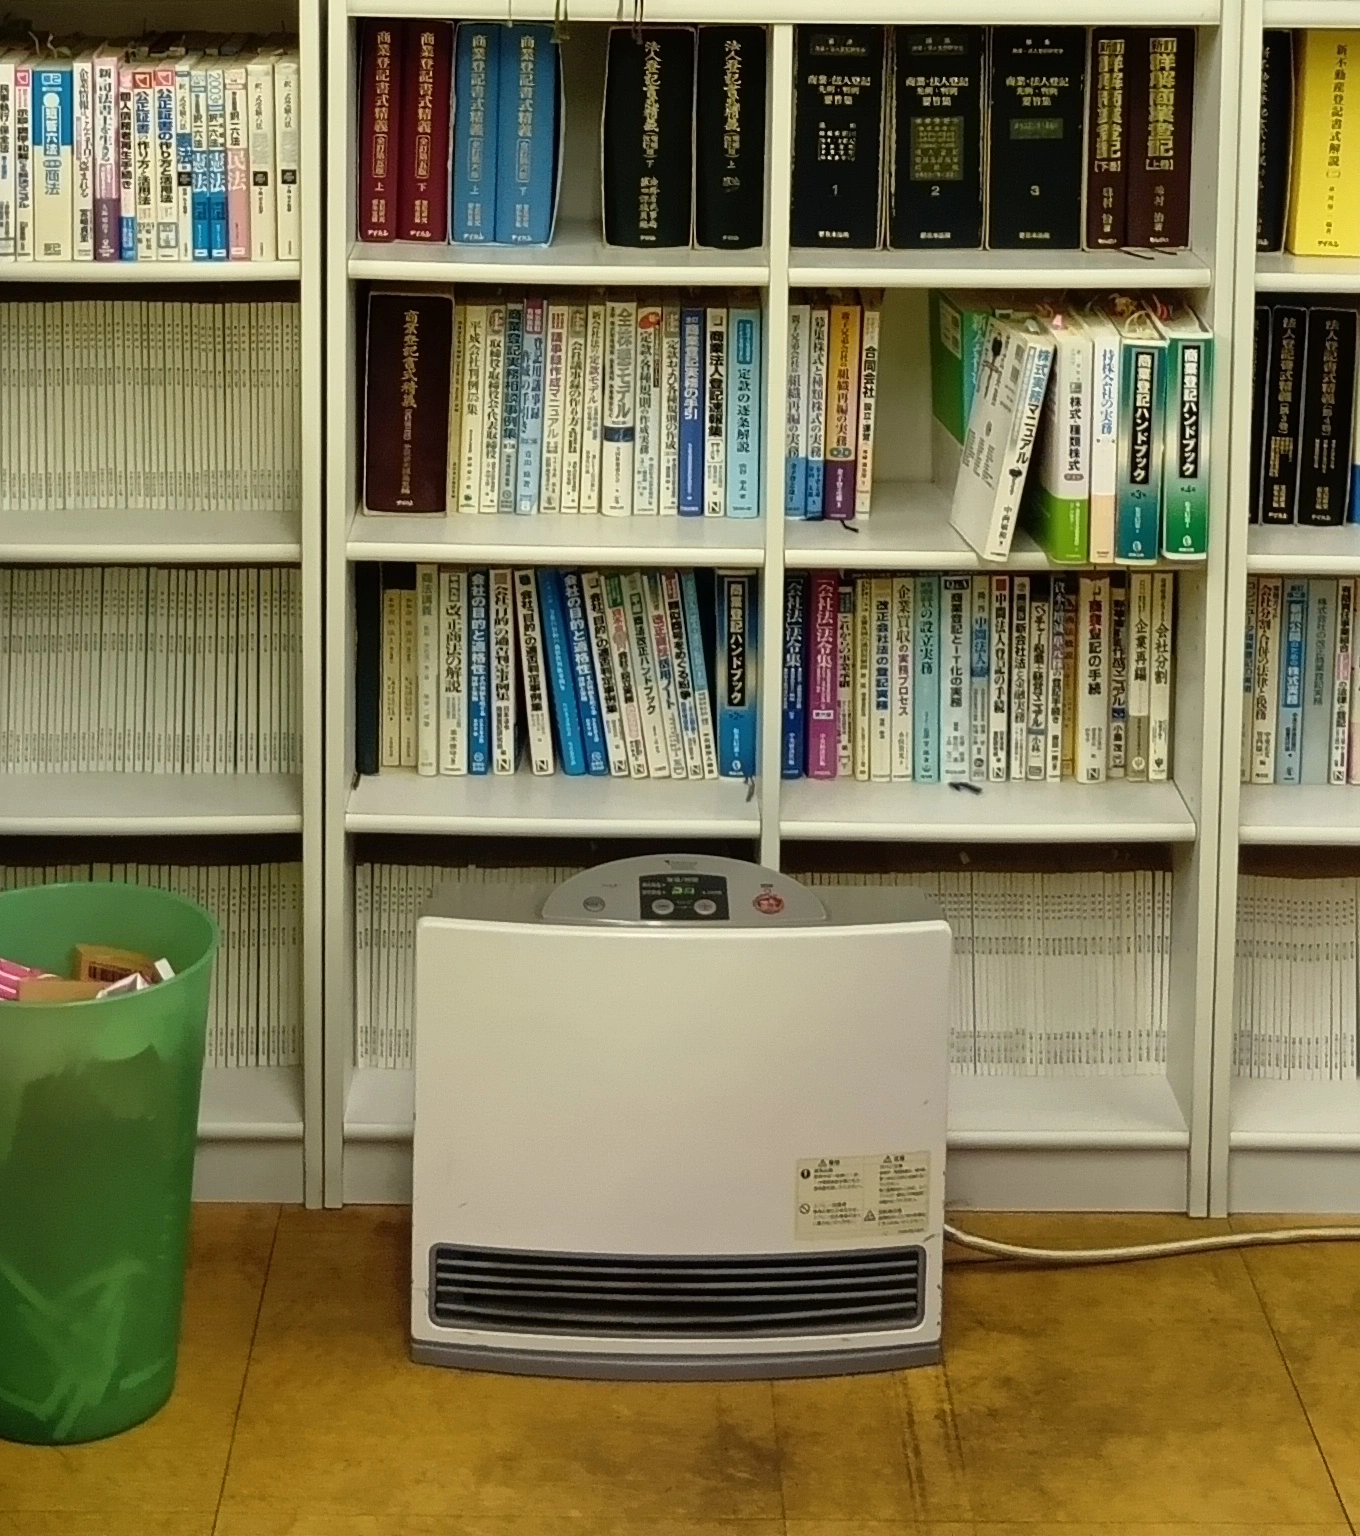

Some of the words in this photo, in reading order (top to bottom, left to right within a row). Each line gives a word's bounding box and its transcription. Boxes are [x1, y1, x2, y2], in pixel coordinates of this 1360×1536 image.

[374, 30, 391, 133] 商業登記書式精義
[416, 32, 435, 134] 商業登記書式精義
[469, 35, 487, 137] 商業登記書式精義
[518, 35, 536, 138] 商業登記書式精義
[808, 74, 871, 87] 商業・法人登記
[905, 75, 969, 88] 商業・法人登記
[1005, 75, 1070, 88] 商業・法人登記
[1096, 54, 1125, 159] 詳解商業登記
[1146, 54, 1177, 158] 詳解商業登記
[1328, 43, 1349, 167] 新不動産登記書式解説
[45, 167, 61, 196] 商法
[156, 89, 174, 204] 公正証書の作り方と活用法
[193, 151, 208, 193] 憲法
[209, 150, 226, 193] 憲法
[227, 149, 247, 192] 民法
[367, 229, 389, 237] テイハン
[410, 230, 432, 238] テイハン
[548, 332, 562, 439] 議事録作成マニュアル
[736, 368, 752, 453] 定款の逐条解説
[862, 345, 877, 399] 合同会社
[1015, 348, 1053, 464] 株式実務マニュアル
[1100, 349, 1116, 436] 持株会社の実務
[1132, 352, 1153, 482] 商業登記ハンドブック
[1181, 348, 1198, 475] 商業登記ハンドブック
[470, 573, 486, 675] 会社の目的と適格性
[816, 578, 834, 668] 「会社法」法令集
[944, 579, 969, 590] Q&A
[445, 604, 462, 693] 改正商法の解説
[875, 599, 889, 711] 改正会社法の登記実務
[896, 584, 911, 717] 企業買収の実務プロセス
[950, 592, 963, 708] 商業登記とIT化の実務
[993, 594, 1007, 714] 中間法人登記の手続
[1087, 600, 1103, 695] 商業登記の手続
[1134, 619, 1147, 682] 企業再編
[1154, 623, 1169, 685] 会社分割
